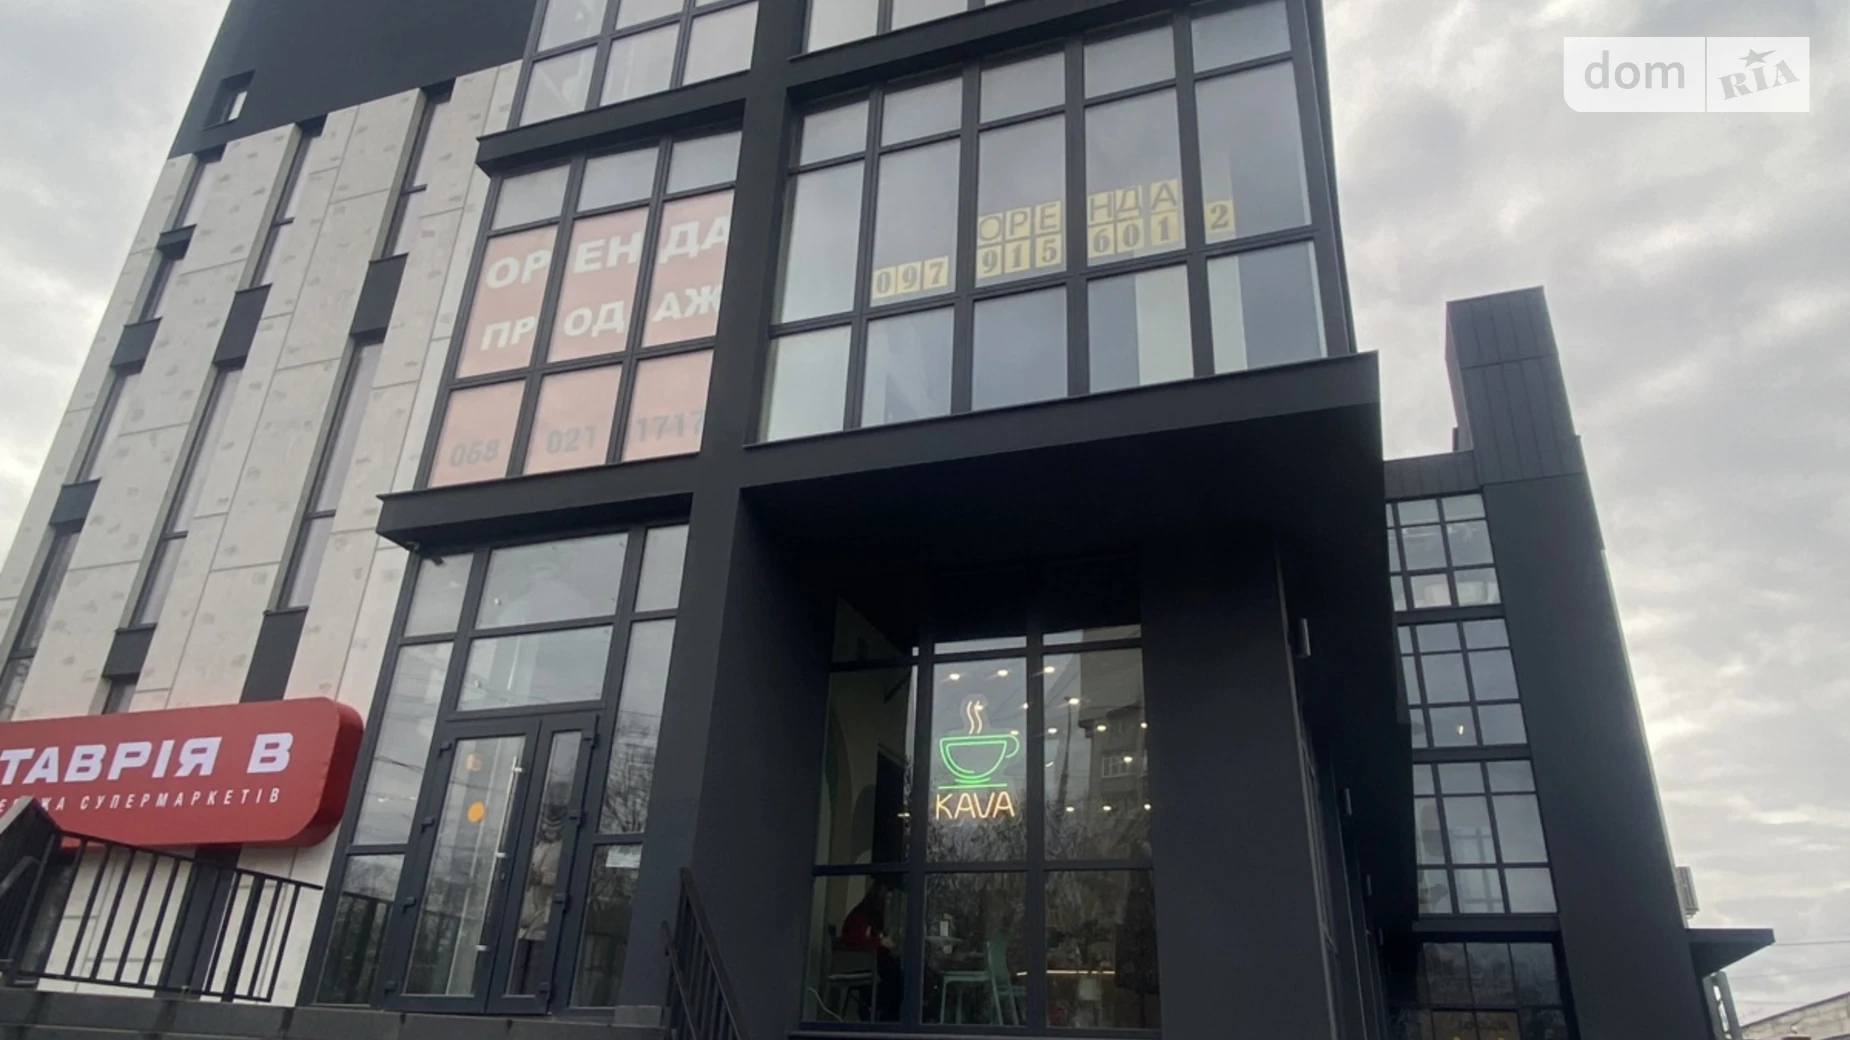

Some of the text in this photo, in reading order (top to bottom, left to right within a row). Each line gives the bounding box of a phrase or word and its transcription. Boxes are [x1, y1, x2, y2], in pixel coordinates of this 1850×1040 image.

[876, 260, 943, 295] 097
[982, 236, 1057, 275] 915
[546, 424, 598, 455] 021
[247, 732, 294, 774] В
[80, 787, 281, 811] СУПЕРМАРКЕТІВ
[934, 790, 1016, 820] KAVA
